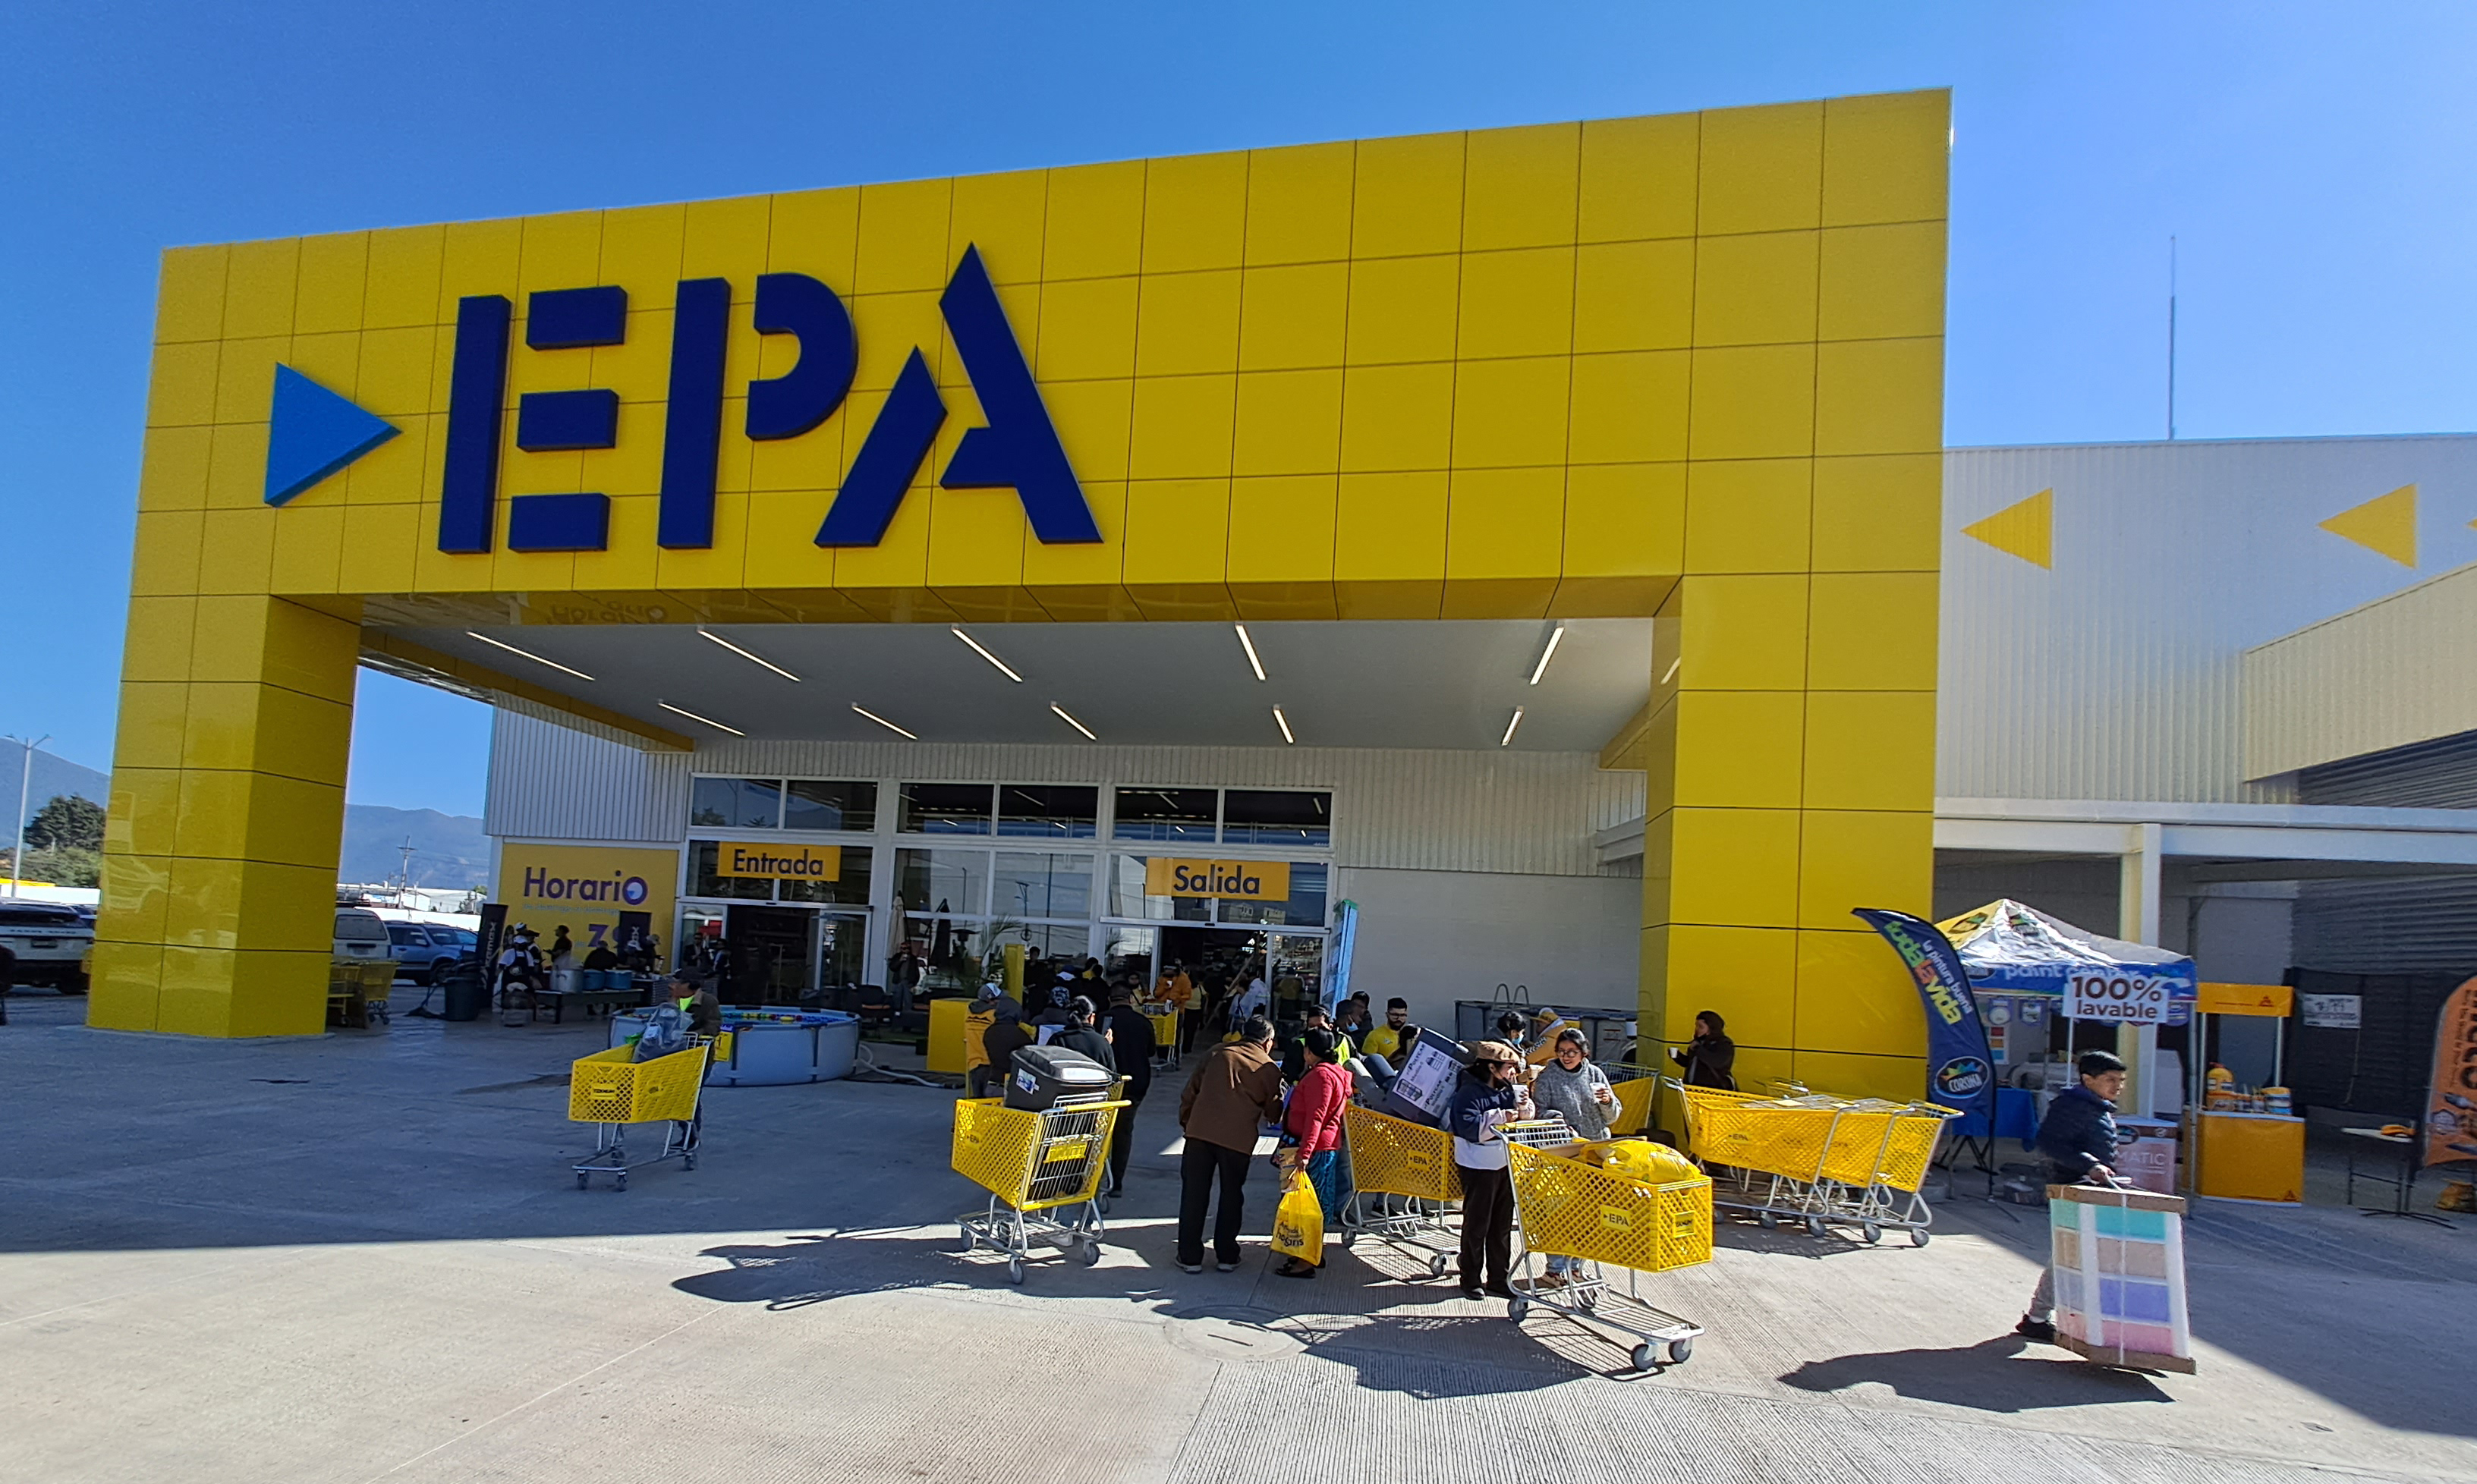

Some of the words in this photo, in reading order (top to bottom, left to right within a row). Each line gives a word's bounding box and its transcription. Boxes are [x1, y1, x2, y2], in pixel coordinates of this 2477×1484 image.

[438, 241, 1103, 555] EPA
[733, 849, 823, 876] Entrada
[524, 866, 648, 905] Horario
[1173, 864, 1260, 894] Salida
[1927, 950, 1955, 986] pintura
[1950, 981, 1972, 1014] buena
[2004, 964, 2063, 980] paint
[2073, 976, 2161, 1001] 100%
[2077, 999, 2158, 1019] lavable
[1949, 1073, 1982, 1093] CORONA
[1413, 1155, 1427, 1165] EPA
[1609, 1213, 1629, 1227] EPA
